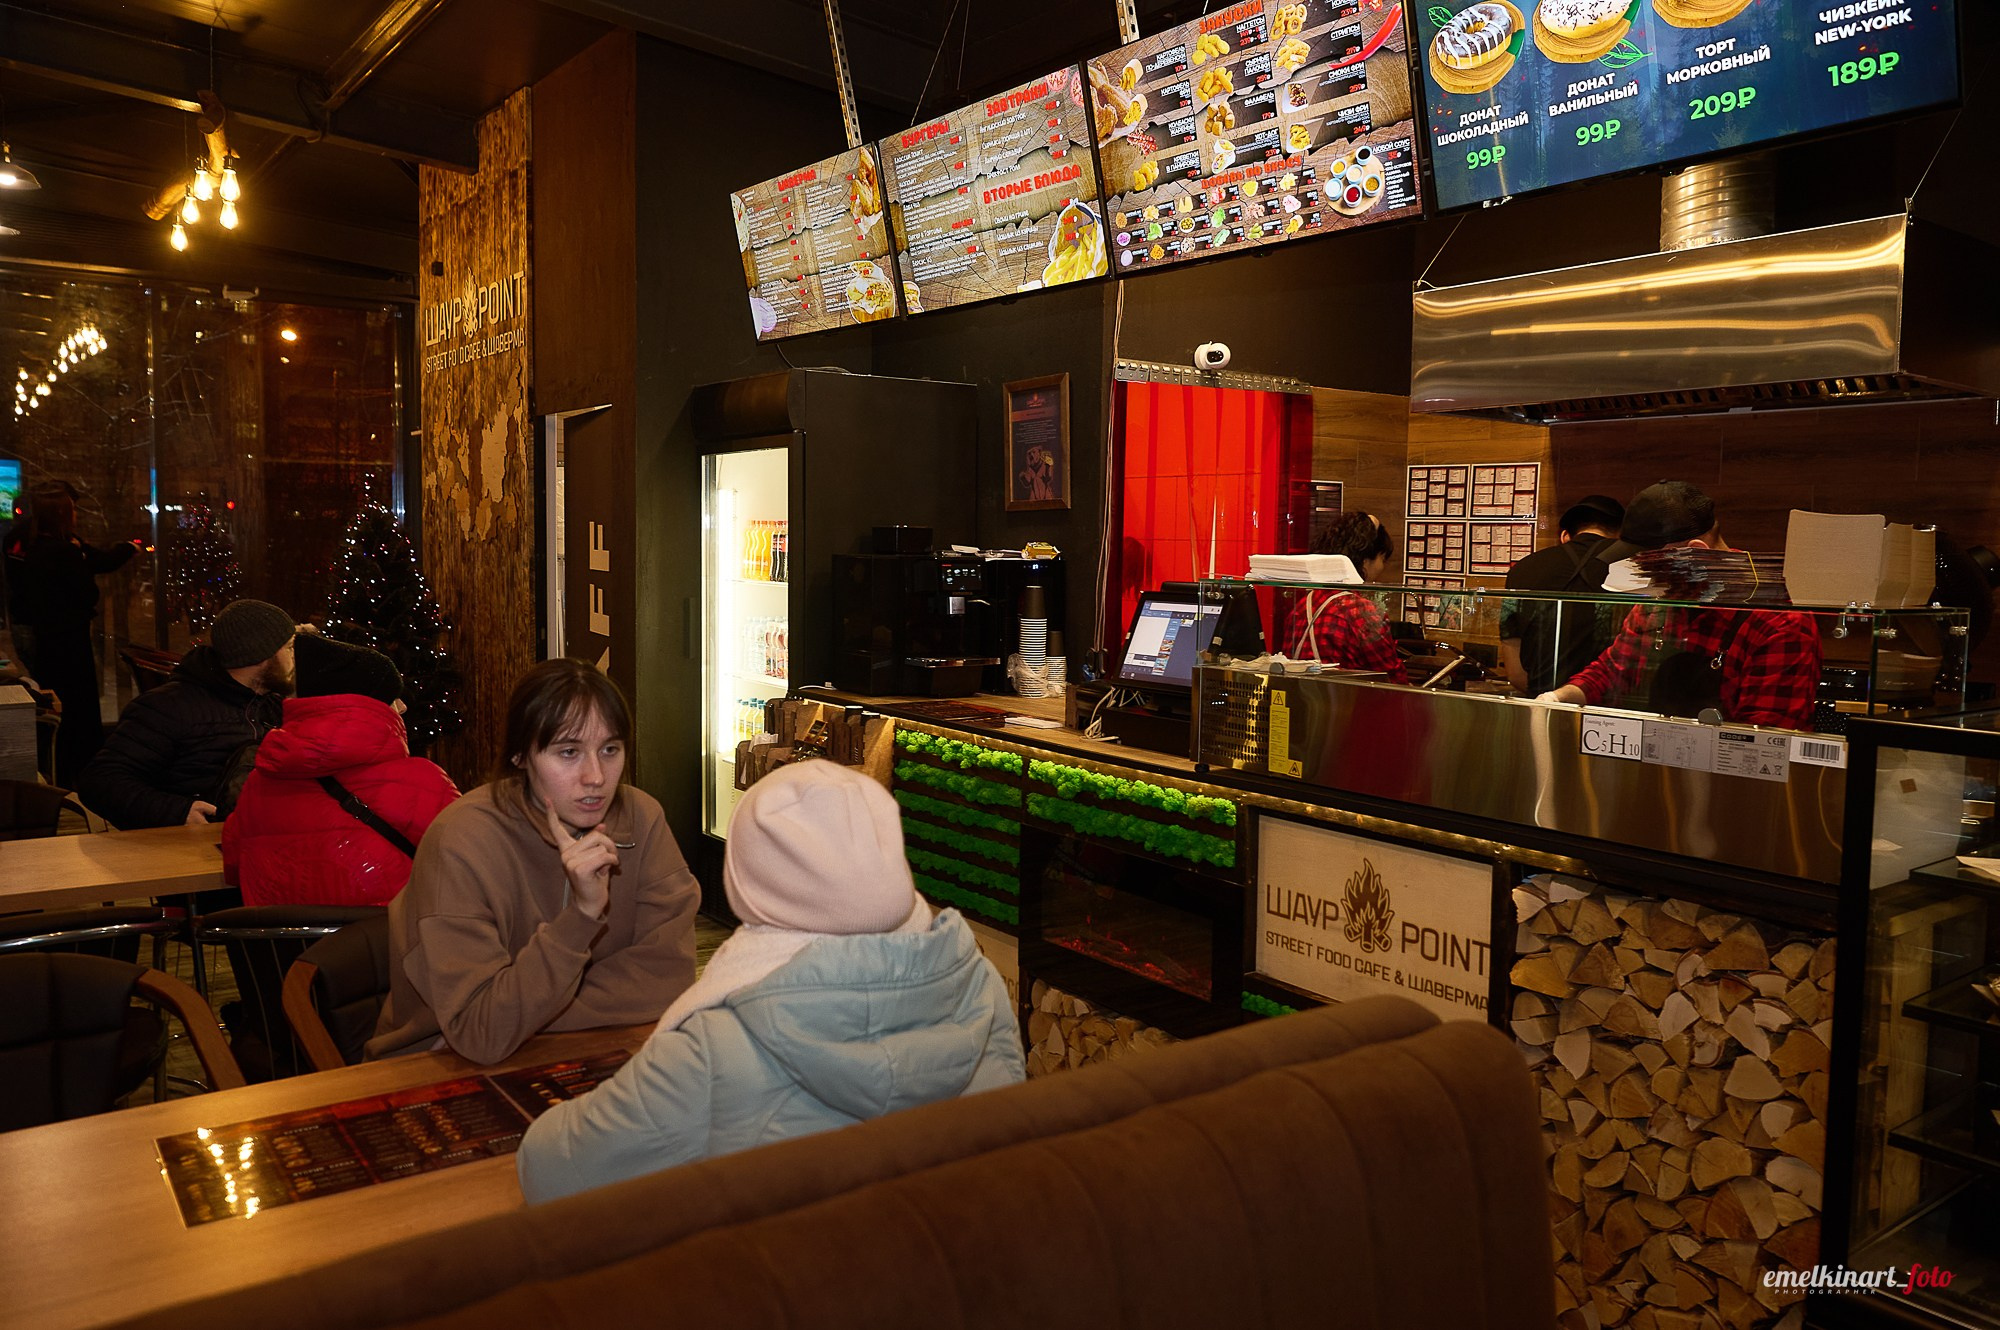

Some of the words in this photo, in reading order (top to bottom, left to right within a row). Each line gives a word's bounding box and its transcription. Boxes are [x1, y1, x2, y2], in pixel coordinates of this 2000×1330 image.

[1199, 0, 1264, 34] ЗАКУСКИ
[1814, 8, 1913, 45] NEW-YORK
[1666, 44, 1772, 85] МОРКОВНЫЙ
[1695, 37, 1737, 59] ТОРТ
[1567, 72, 1616, 97] ДОНАТ
[1827, 51, 1900, 87] 189₽
[986, 82, 1049, 117] ЗАВТРАКИ
[1459, 105, 1502, 127] ДОНАТ
[1548, 80, 1639, 117] ВАНИЛЬНЫЙ
[1688, 86, 1757, 120] 209₽
[901, 119, 949, 149] БУРГЕРЫ
[1437, 111, 1530, 147] ШОКОЛАДНЫЙ
[1575, 119, 1621, 146] 99₽
[1246, 165, 1262, 178] ПО
[1264, 155, 1303, 173] ВКУСУ
[1466, 145, 1506, 170] 99₽
[982, 178, 1032, 205] ВТОРЫЕ
[1033, 163, 1081, 190] БЛЮДА
[425, 296, 462, 347] ШАУР
[478, 270, 524, 329] POINT
[426, 351, 448, 374] STREET
[464, 341, 481, 363] CAFE
[482, 340, 488, 357] &
[487, 328, 525, 356] ШАВЕРМА
[1266, 884, 1340, 931] ШАУР
[1401, 920, 1491, 976] POINT
[1265, 930, 1314, 957] STREET
[1316, 946, 1352, 969] FOOD
[1354, 958, 1391, 983] CAFE
[1394, 969, 1404, 987] &
[1408, 973, 1489, 1012] ШАВЕРМА
